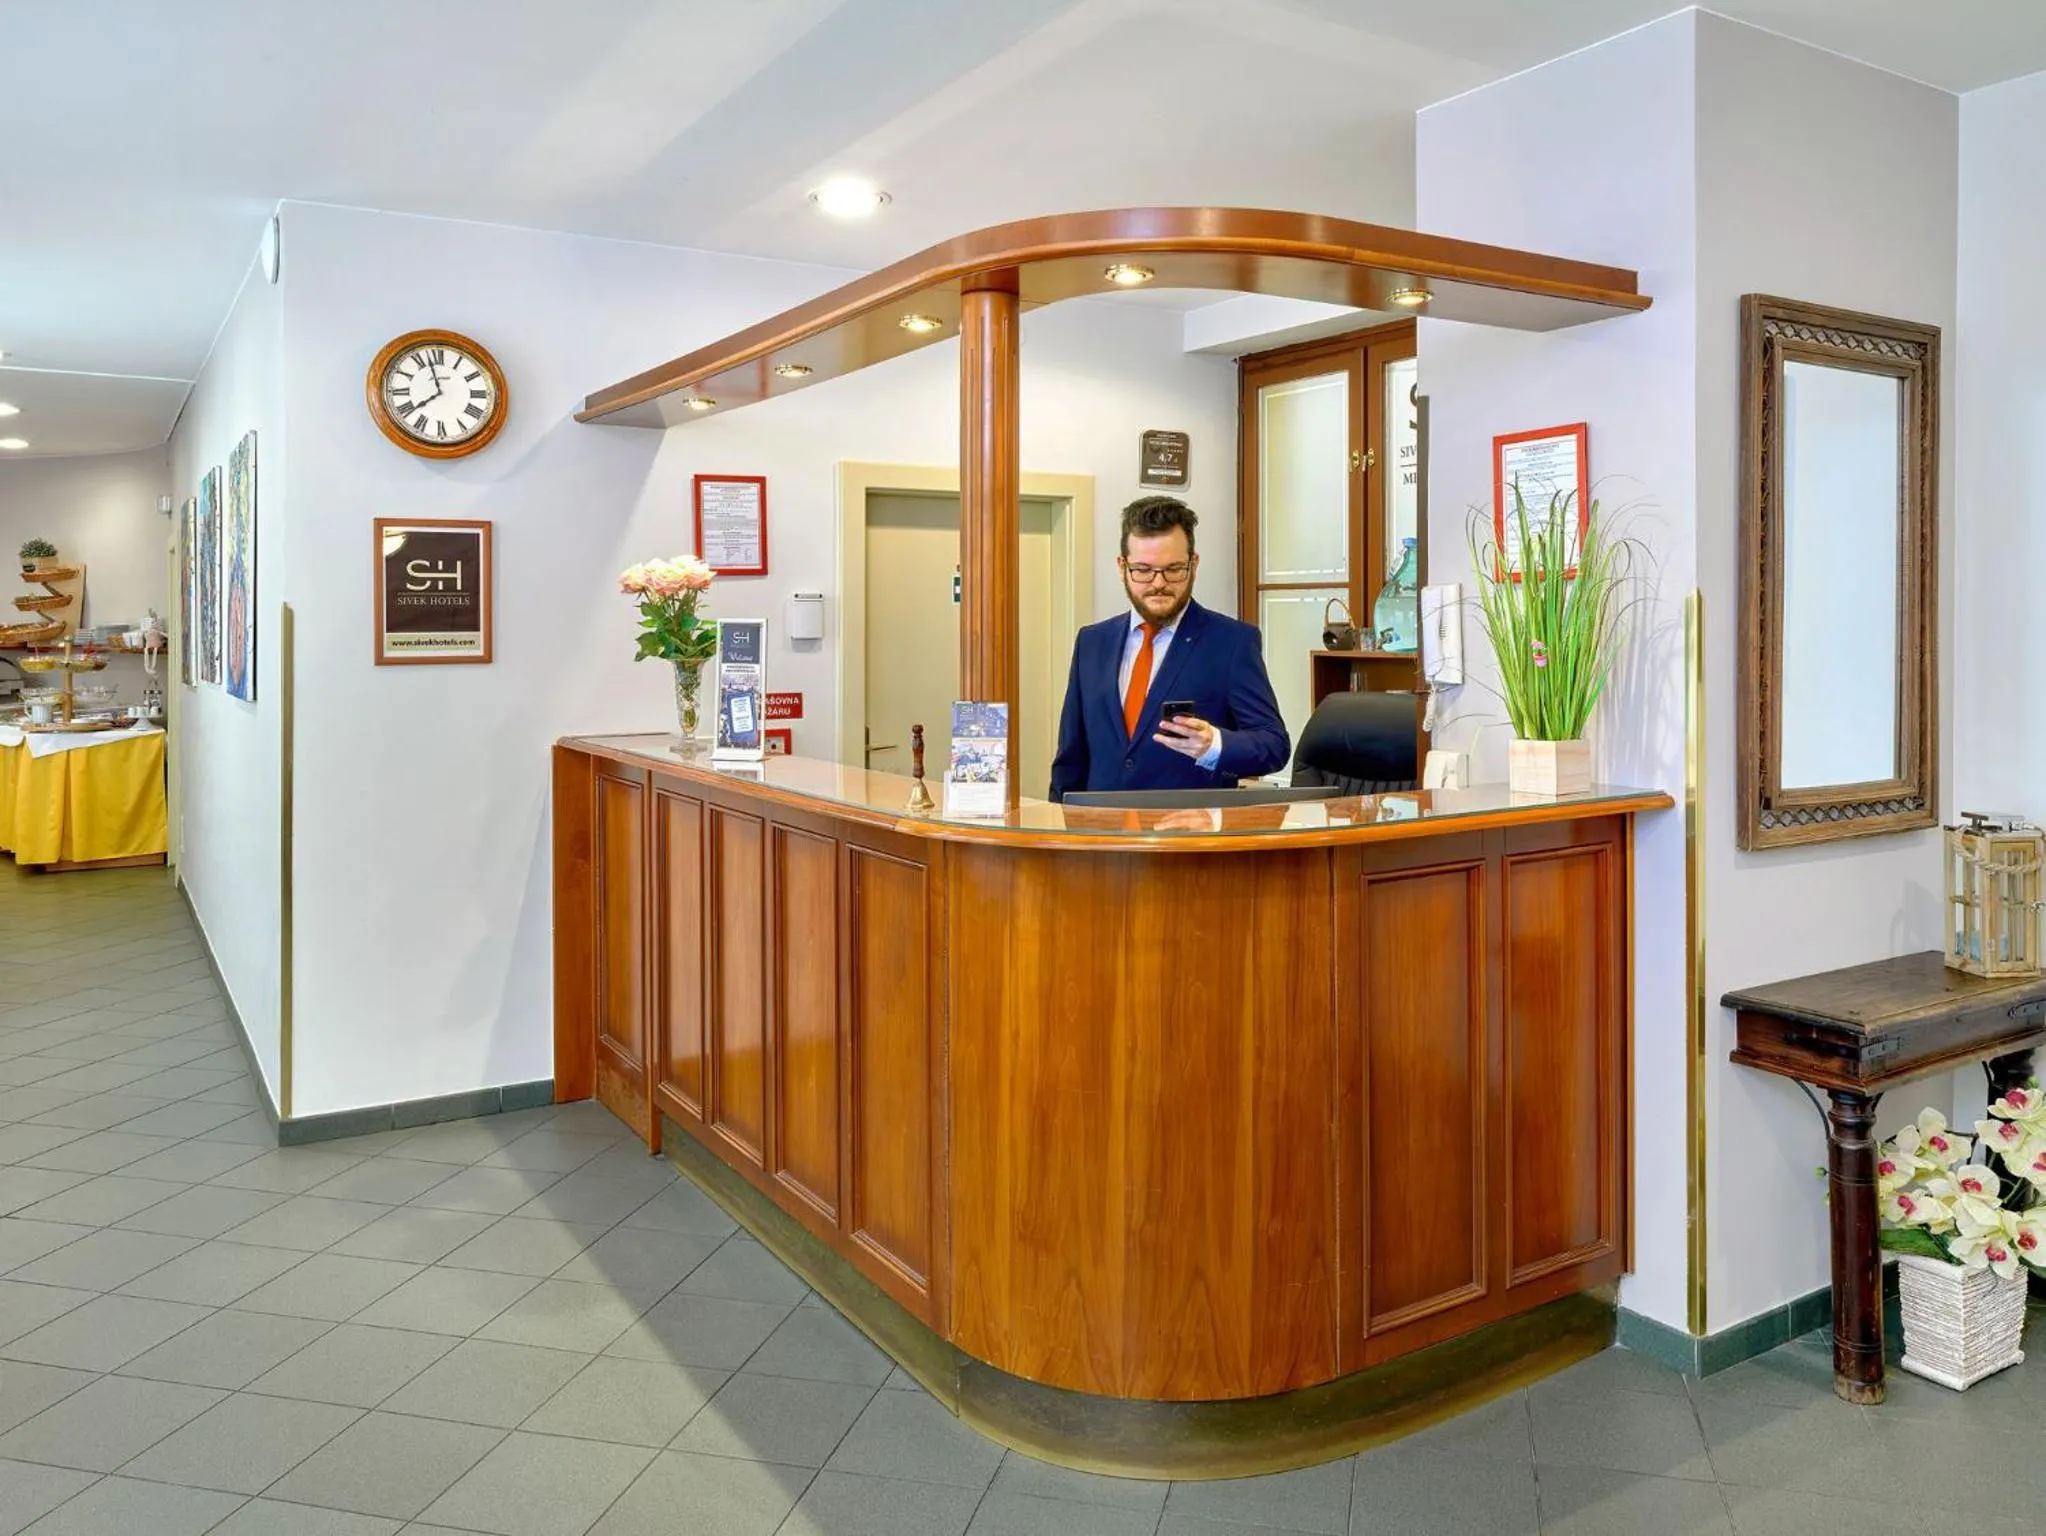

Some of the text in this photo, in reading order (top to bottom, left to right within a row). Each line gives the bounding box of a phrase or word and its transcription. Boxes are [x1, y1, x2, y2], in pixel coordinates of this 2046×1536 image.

[406, 559, 462, 591] SH
[397, 596, 471, 606] SIVEK HOTELS
[391, 638, 476, 647] www.sivekhotels.com
[765, 706, 791, 716] ŽÁRU
